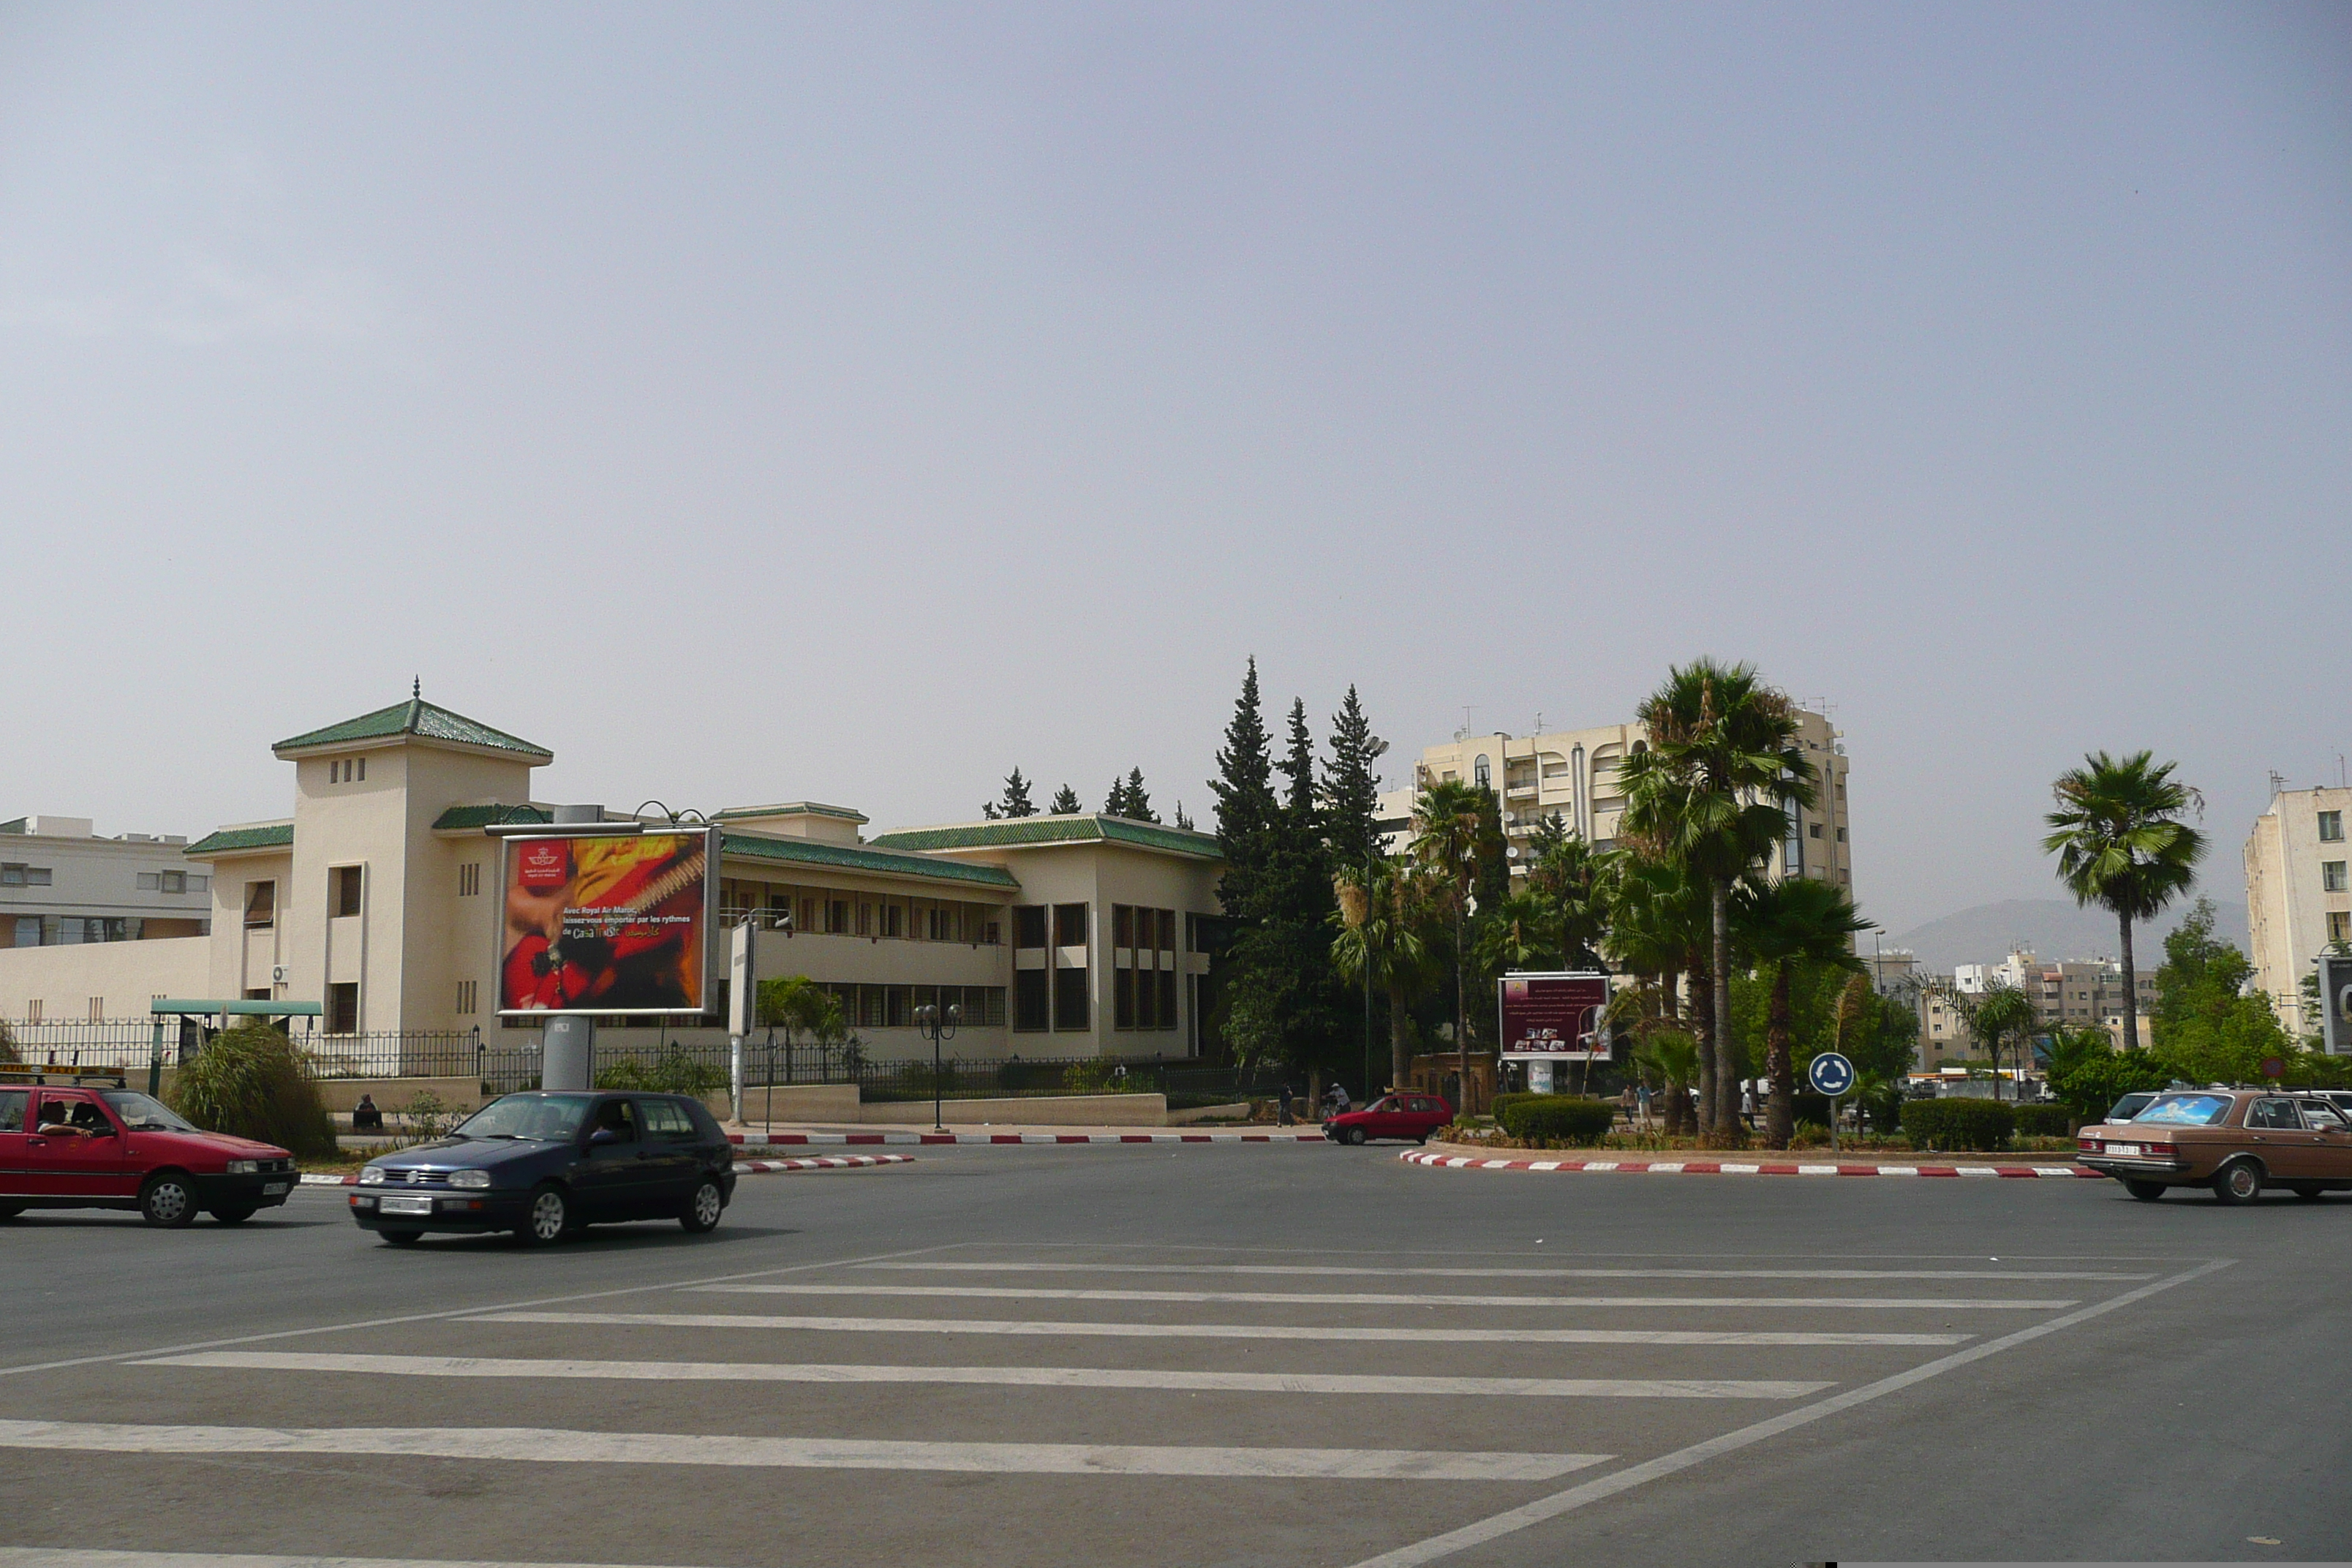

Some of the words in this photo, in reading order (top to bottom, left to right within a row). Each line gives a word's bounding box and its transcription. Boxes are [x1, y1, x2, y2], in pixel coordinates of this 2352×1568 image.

[581, 907, 600, 916] Royal
[613, 906, 638, 914] Maroc,
[563, 916, 603, 924] laissez-vous
[604, 916, 636, 925] emporter
[637, 917, 649, 925] par
[650, 915, 660, 923] les
[662, 915, 691, 924] rythmes
